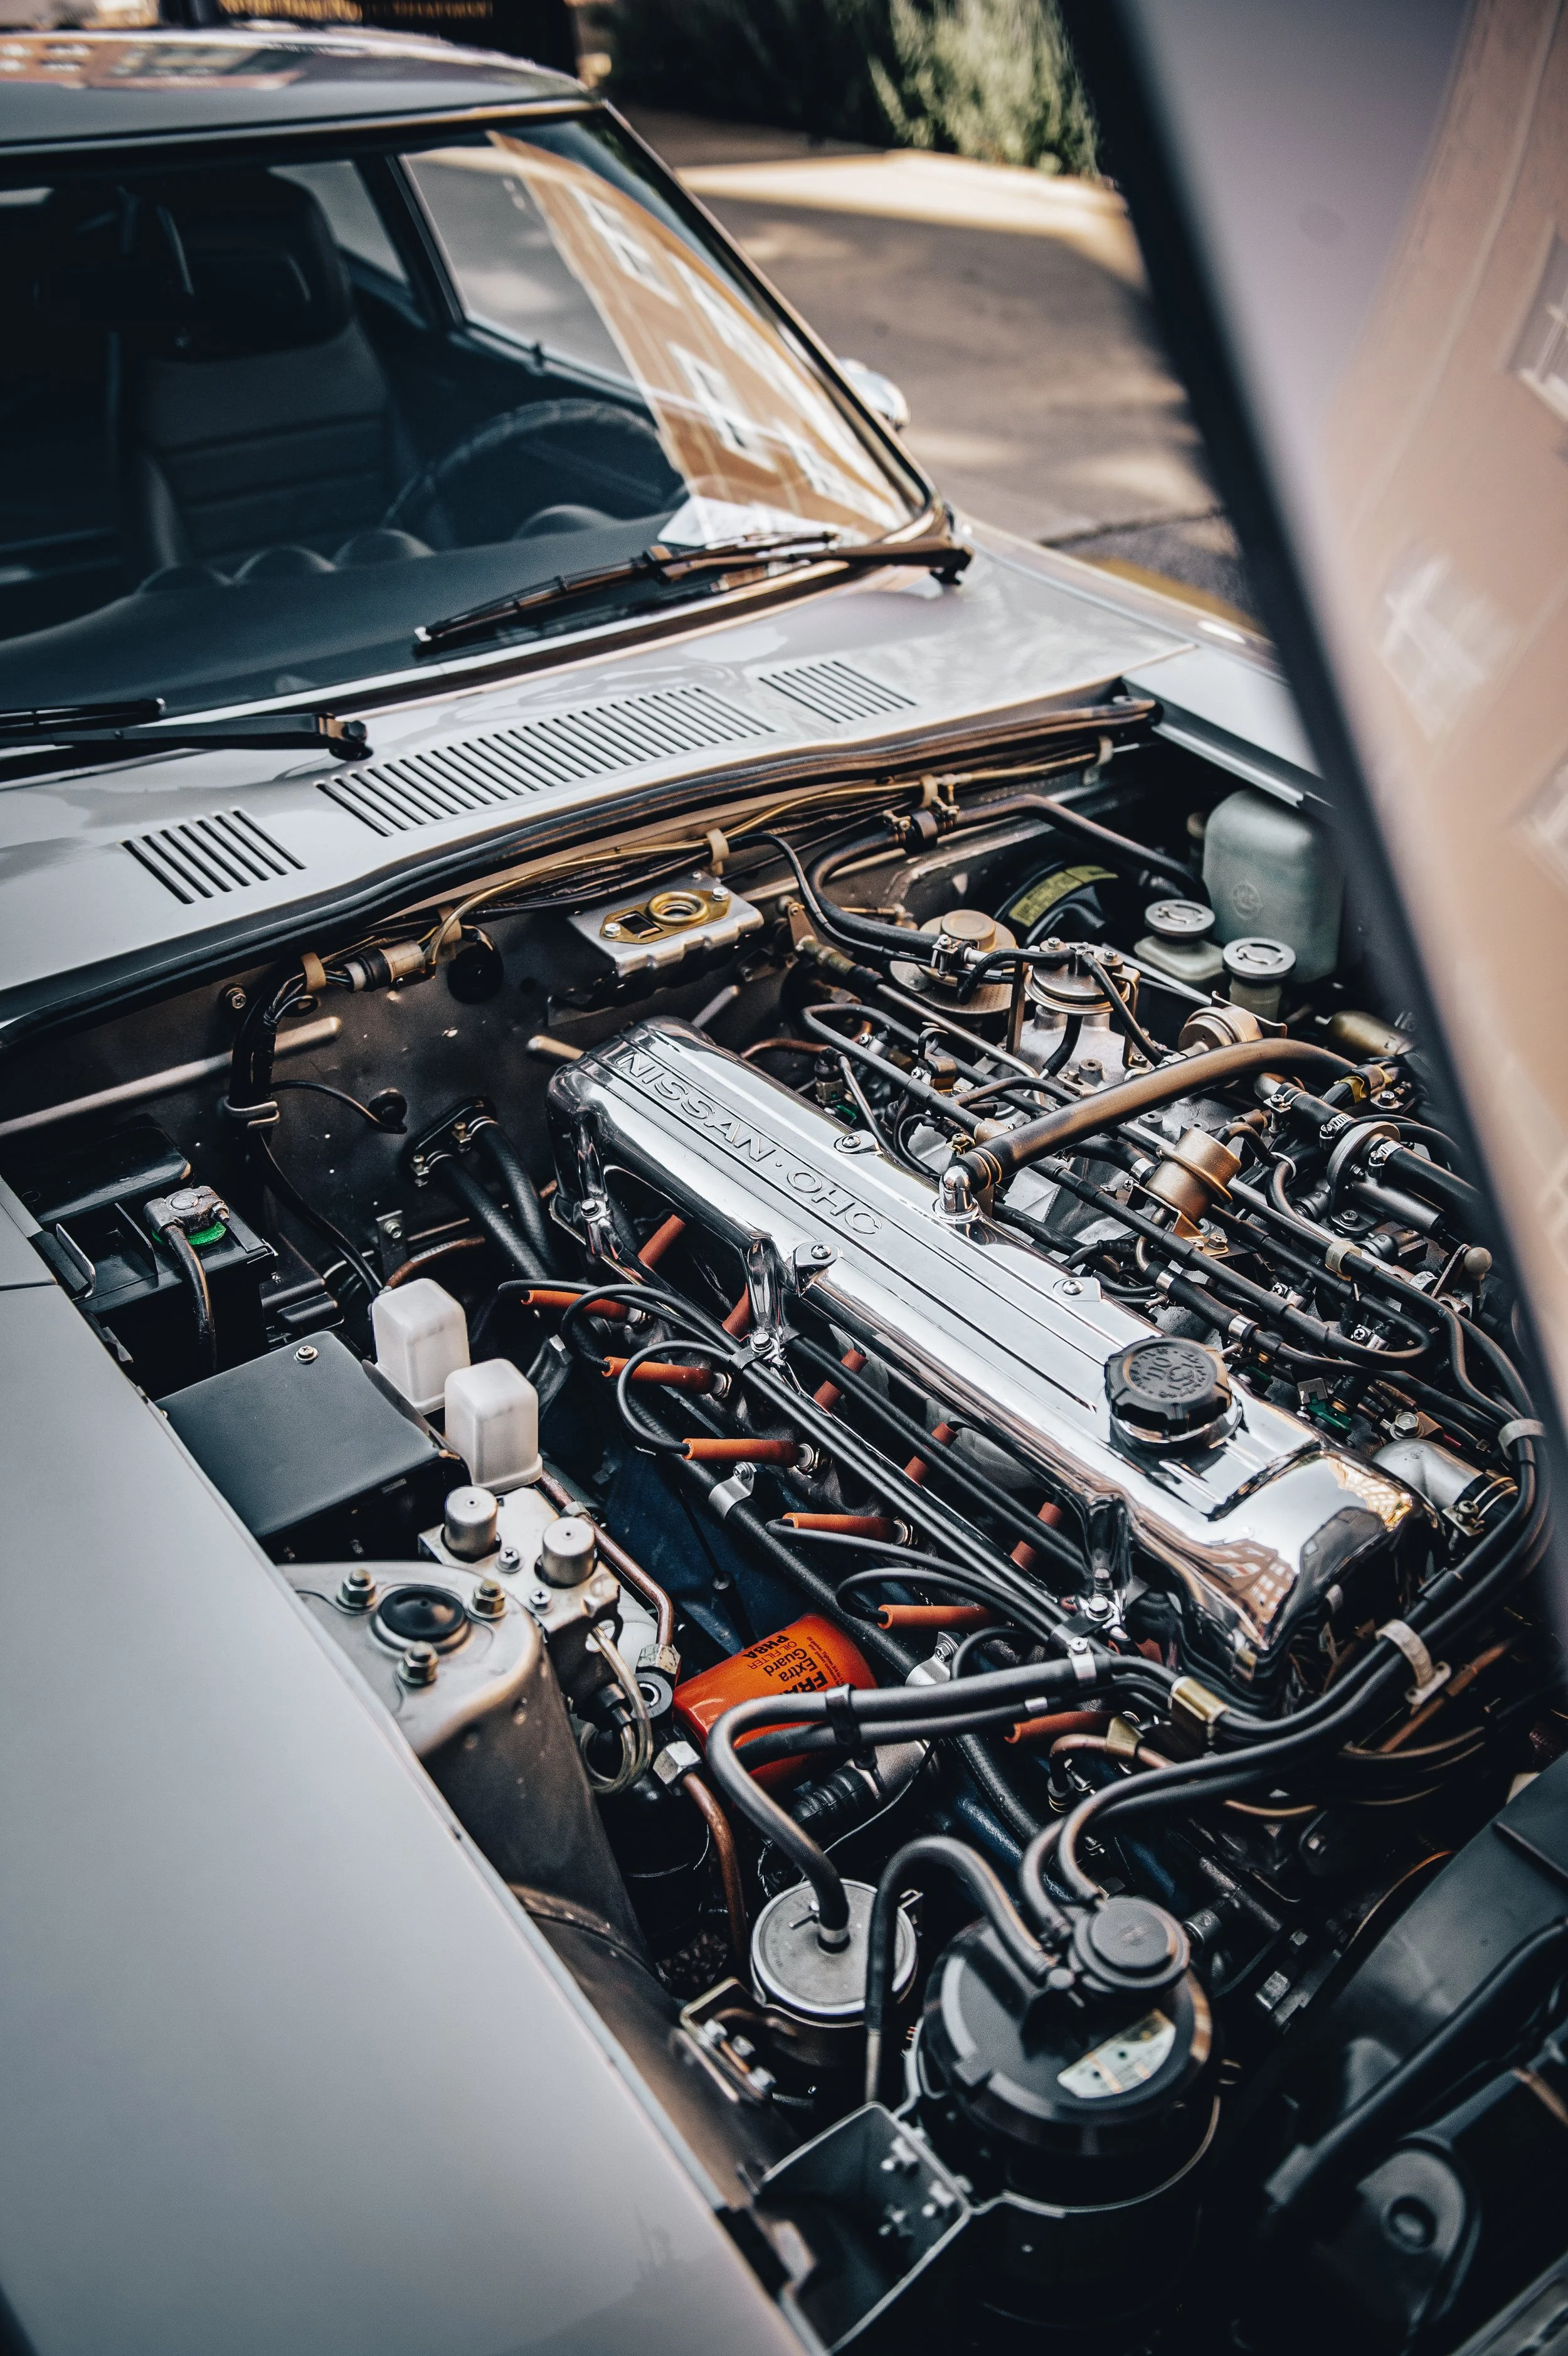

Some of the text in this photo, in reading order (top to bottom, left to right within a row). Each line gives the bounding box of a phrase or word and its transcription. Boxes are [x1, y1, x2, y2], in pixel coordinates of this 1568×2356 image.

[617, 1053, 883, 1235] NISSAN OHC
[743, 1635, 790, 1659] PH8A
[748, 1641, 797, 1670] OIL FILTER
[763, 1648, 807, 1676] Guard
[780, 1659, 817, 1682] Extra
[778, 1671, 828, 1695] FRA
